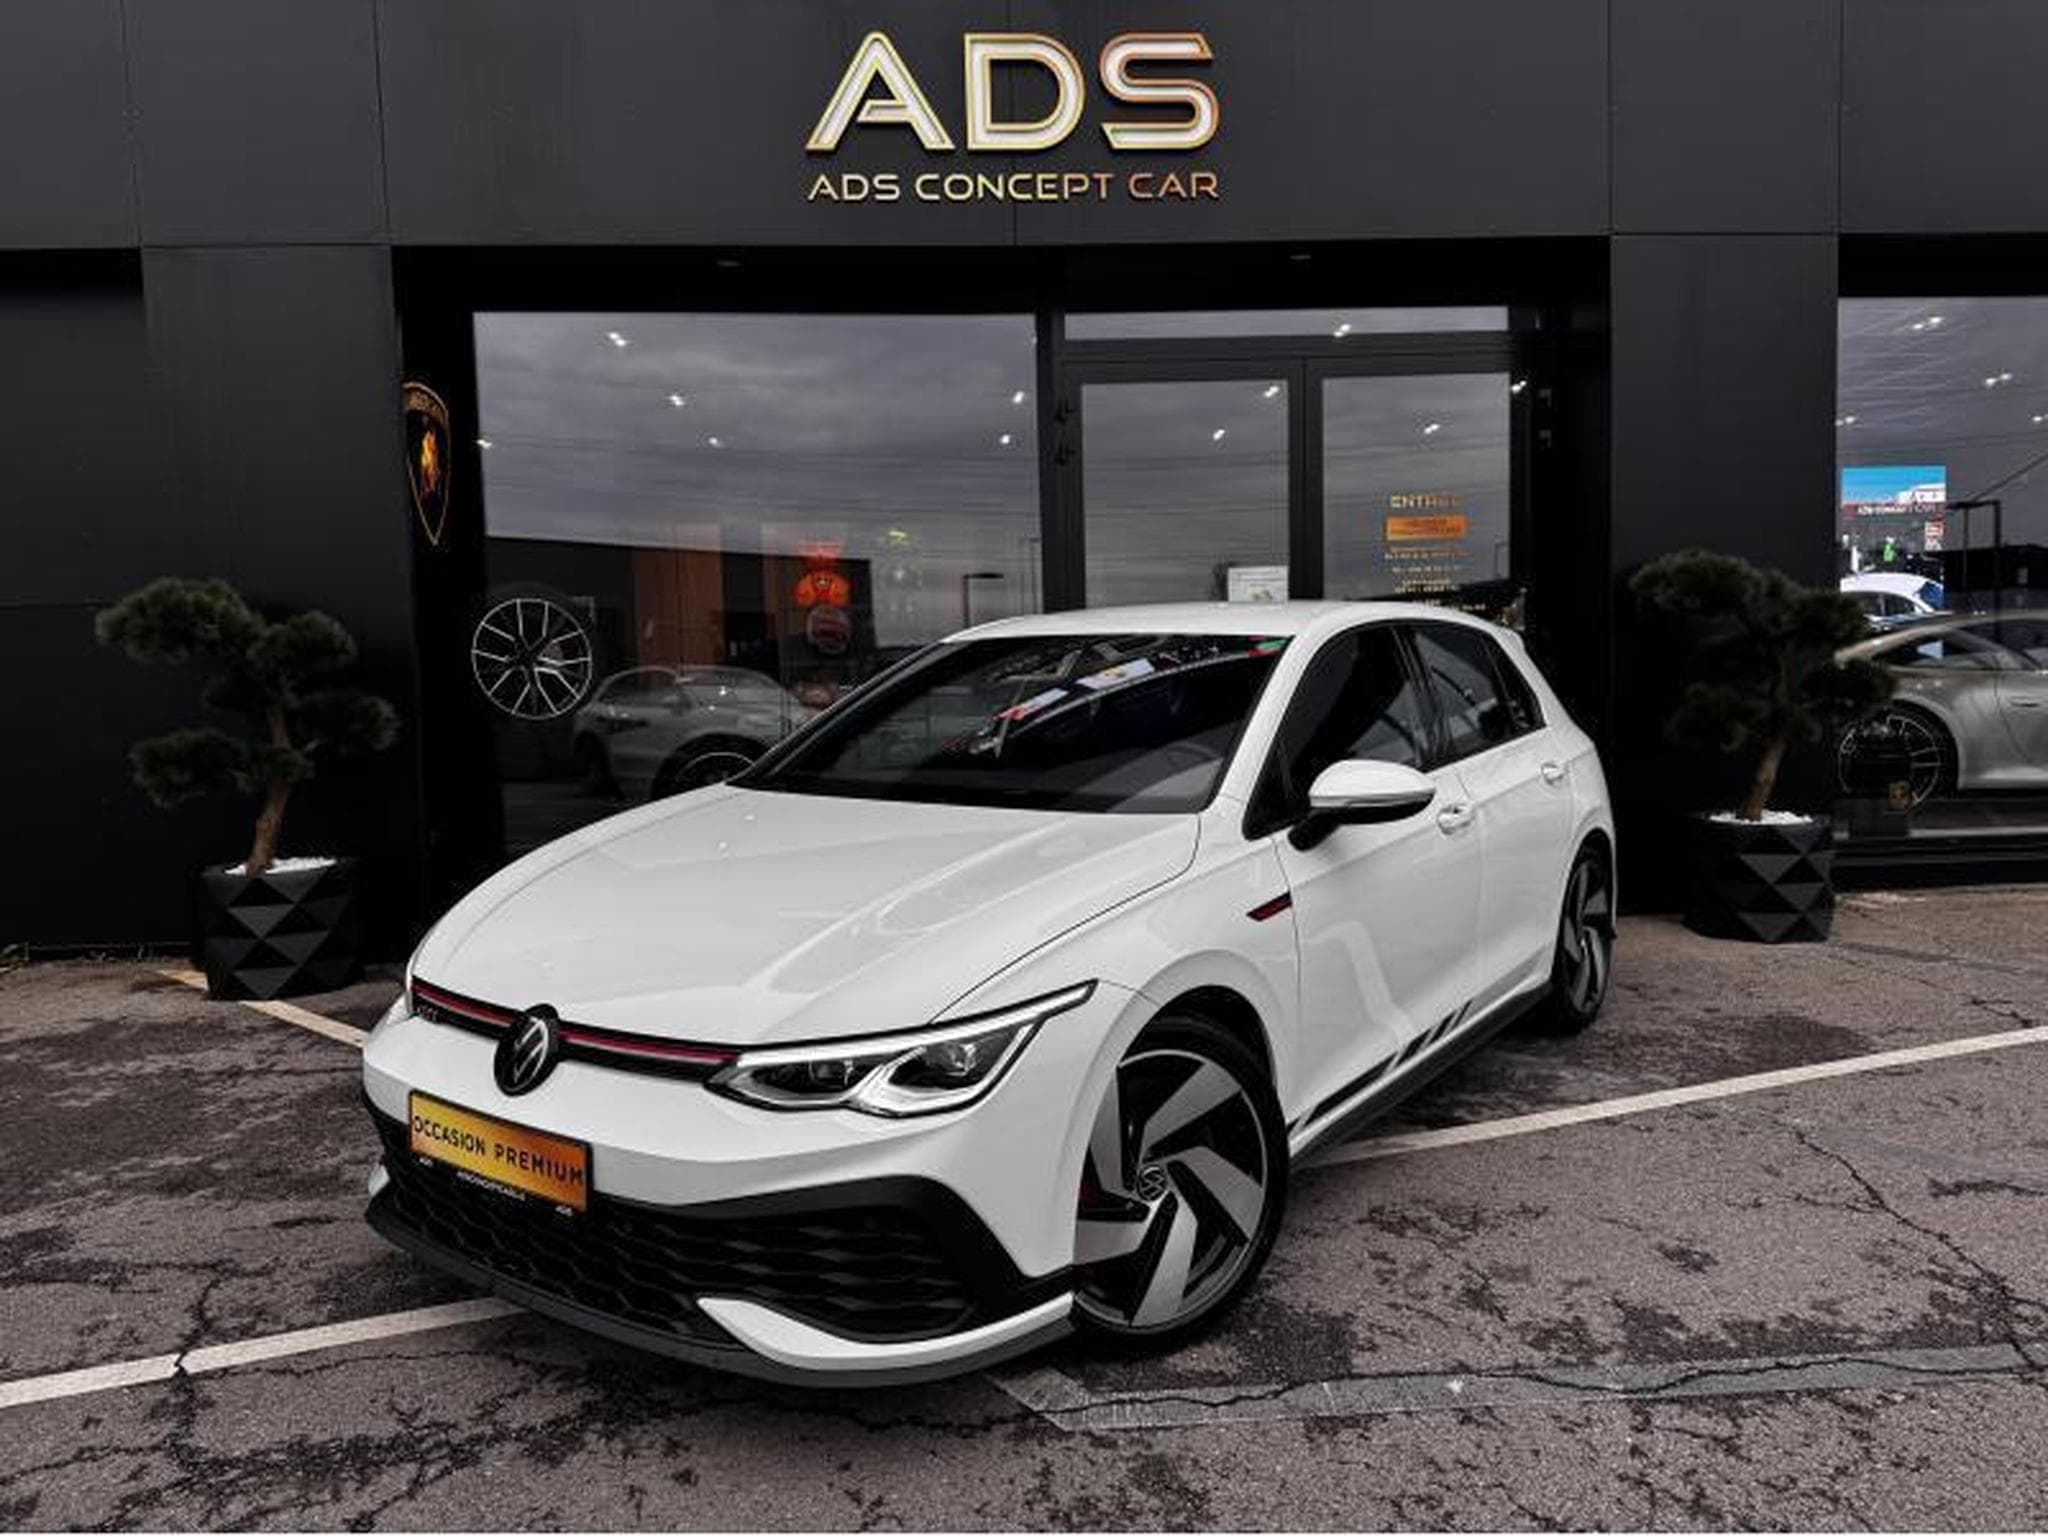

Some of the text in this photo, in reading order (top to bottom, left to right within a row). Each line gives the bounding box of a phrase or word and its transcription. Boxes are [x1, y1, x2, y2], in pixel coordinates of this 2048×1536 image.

[805, 31, 1220, 151] ADS
[808, 172, 1219, 200] ADS CONCEPT CAR
[412, 1115, 584, 1184] OCCASION PREMIUM
